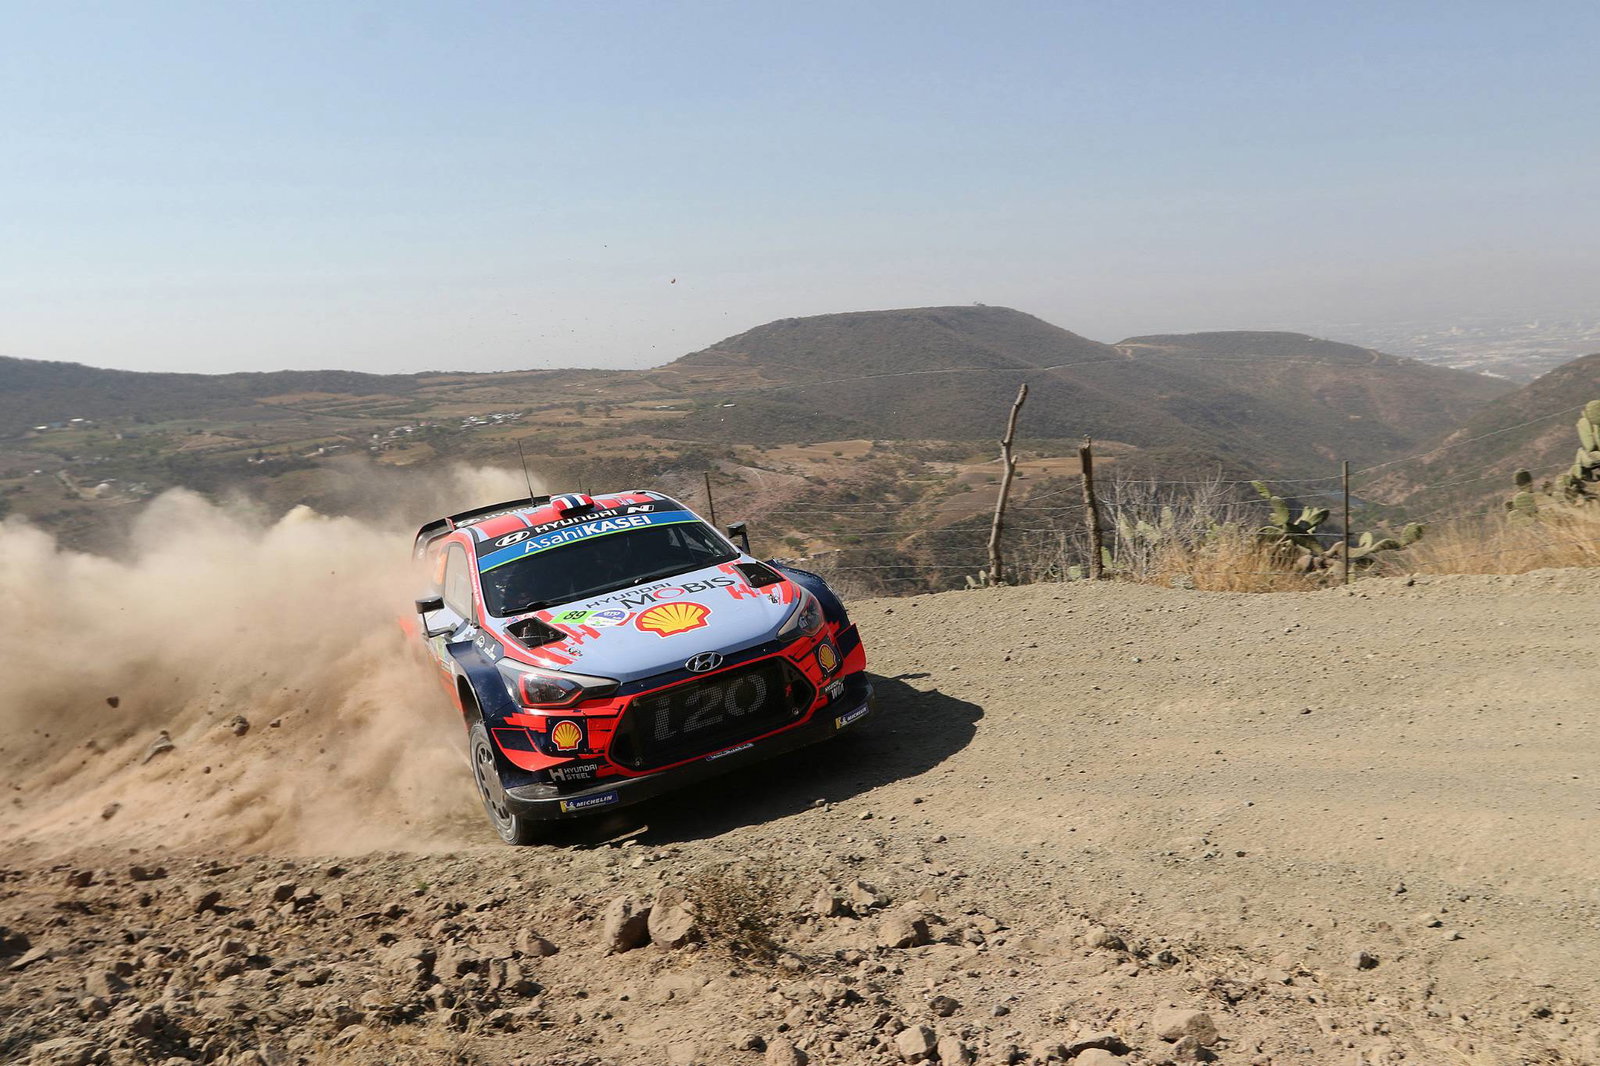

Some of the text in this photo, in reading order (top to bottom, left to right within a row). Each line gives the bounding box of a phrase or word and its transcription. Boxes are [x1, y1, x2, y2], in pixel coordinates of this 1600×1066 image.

[535, 509, 618, 534] HYUNDAI
[524, 515, 652, 553] AsahiKASEI
[586, 582, 672, 609] HYUNDAI
[620, 576, 735, 610] MOBIS
[563, 610, 587, 620] 89
[563, 763, 598, 773] HYUNDAI
[565, 772, 591, 781] STEEL
[576, 795, 613, 808] MICHELIN
